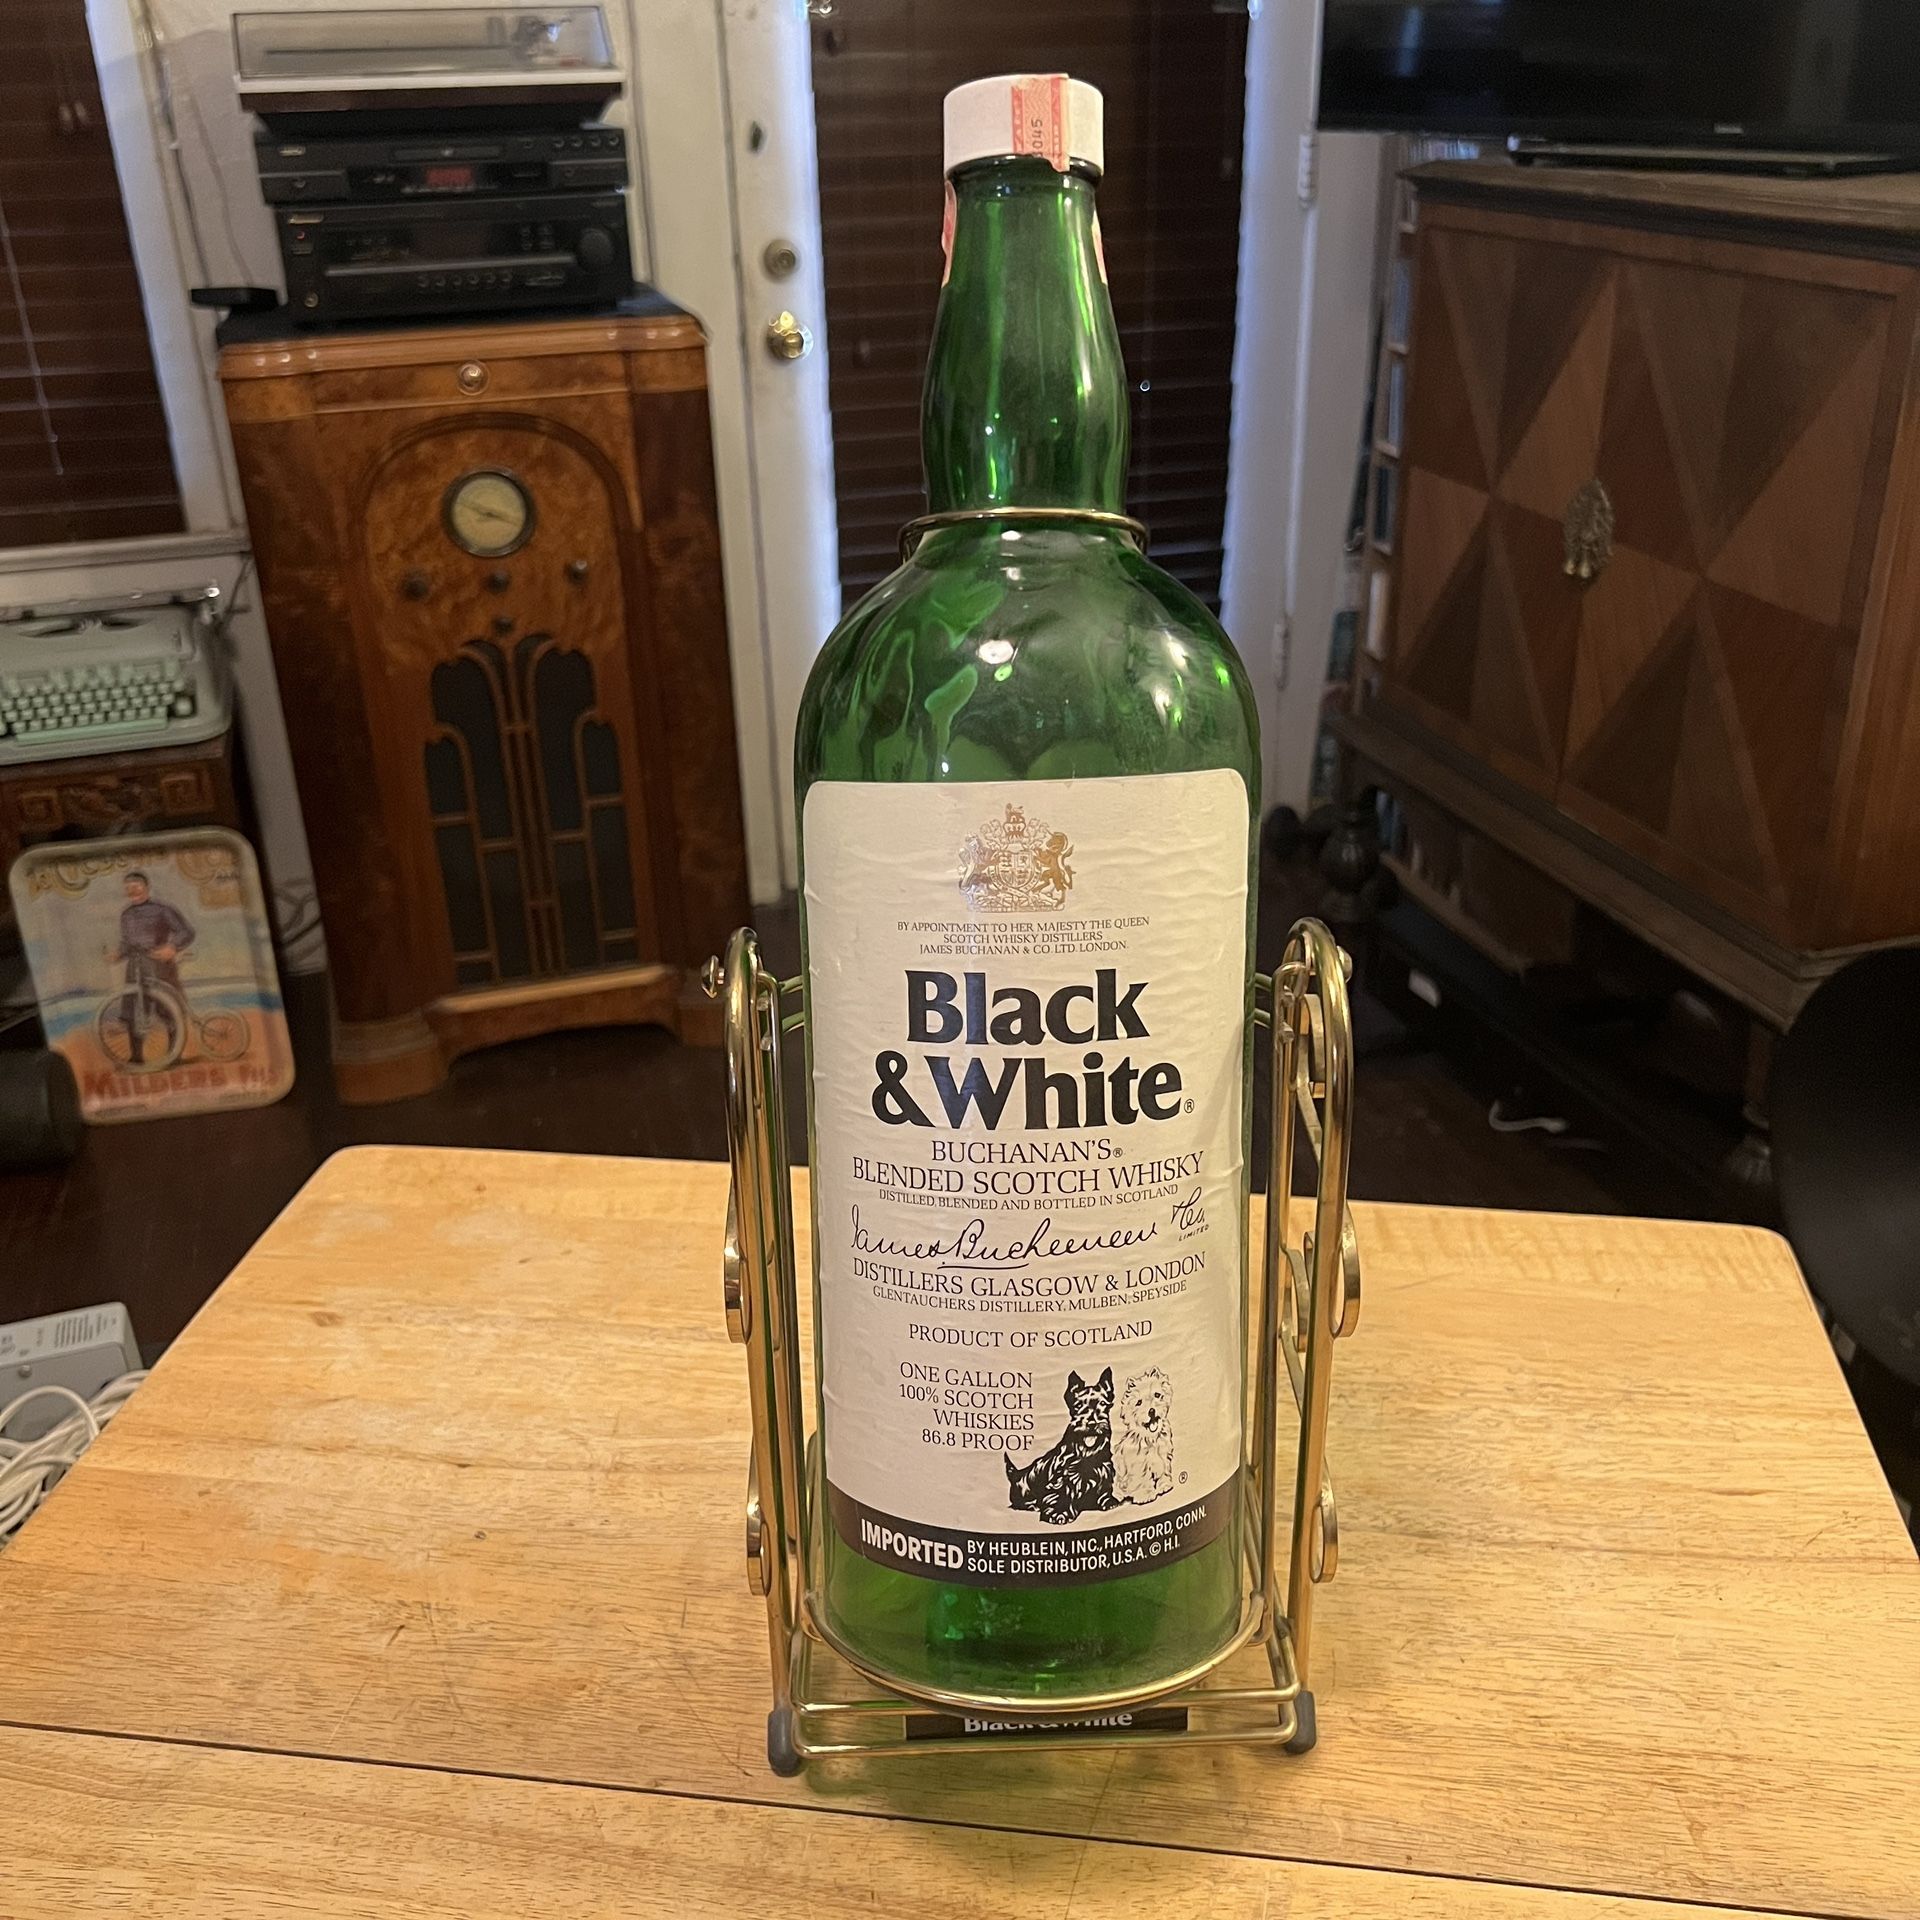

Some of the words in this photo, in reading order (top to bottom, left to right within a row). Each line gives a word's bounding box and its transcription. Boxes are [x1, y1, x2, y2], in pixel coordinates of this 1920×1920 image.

[897, 921, 910, 931] BY
[911, 923, 988, 932] APPOINTMENT
[991, 923, 1008, 932] TO
[1010, 922, 1034, 932] HER
[1037, 920, 1087, 932] MAJESTY
[1088, 919, 1112, 929] THE
[1114, 916, 1150, 930] QUEEN
[944, 934, 989, 944] SCOTCH
[993, 934, 1038, 944] WHISKY
[1042, 931, 1103, 942] DISTILLERS
[920, 944, 952, 954] JAMES
[955, 945, 1021, 955] BUCHANAN
[1022, 946, 1030, 954] &
[905, 968, 1150, 1046] Black
[852, 1156, 965, 1195] BLENDED
[973, 1168, 1100, 1196] SCOTCH
[1108, 1150, 1204, 1189] WHISKY
[938, 1198, 998, 1210] BLENDED
[1000, 1200, 1030, 1210] AND
[1034, 1196, 1096, 1210] BOTTLED
[1100, 1194, 1113, 1207] IN
[1116, 1183, 1178, 1204] SCOTLAND
[1178, 1224, 1210, 1242] LIMITED
[854, 1256, 963, 1295] DISTILLERS
[971, 1274, 1098, 1297] GLASGOW
[1105, 1274, 1119, 1292] &
[1126, 1250, 1206, 1289] LONDON
[873, 1285, 976, 1312] GLENTAUCHERS
[1132, 1279, 1187, 1304] SPEYSIDE
[909, 1323, 1004, 1348] PRODUCT
[1010, 1331, 1038, 1348] OF
[1044, 1320, 1152, 1348] SCOTLAND
[900, 1361, 940, 1383] ONE
[945, 1368, 1032, 1389] GALLON
[899, 1384, 939, 1404] 100%
[944, 1388, 1034, 1410] SCOTCH
[933, 1408, 1034, 1430] WHISKIES
[922, 1428, 956, 1446] 86.8
[962, 1432, 1034, 1451] PROOF
[861, 1518, 964, 1570] IMPORTED
[968, 1540, 985, 1555] BY
[989, 1541, 1069, 1556] HEUBLEIN,
[1104, 1520, 1174, 1550] HARTFORD,
[1176, 1505, 1207, 1530] CONN.
[968, 1558, 1005, 1574] SOLE
[1011, 1554, 1111, 1573] DISTRIBUTOR,
[1112, 1546, 1148, 1566] U.S.A.
